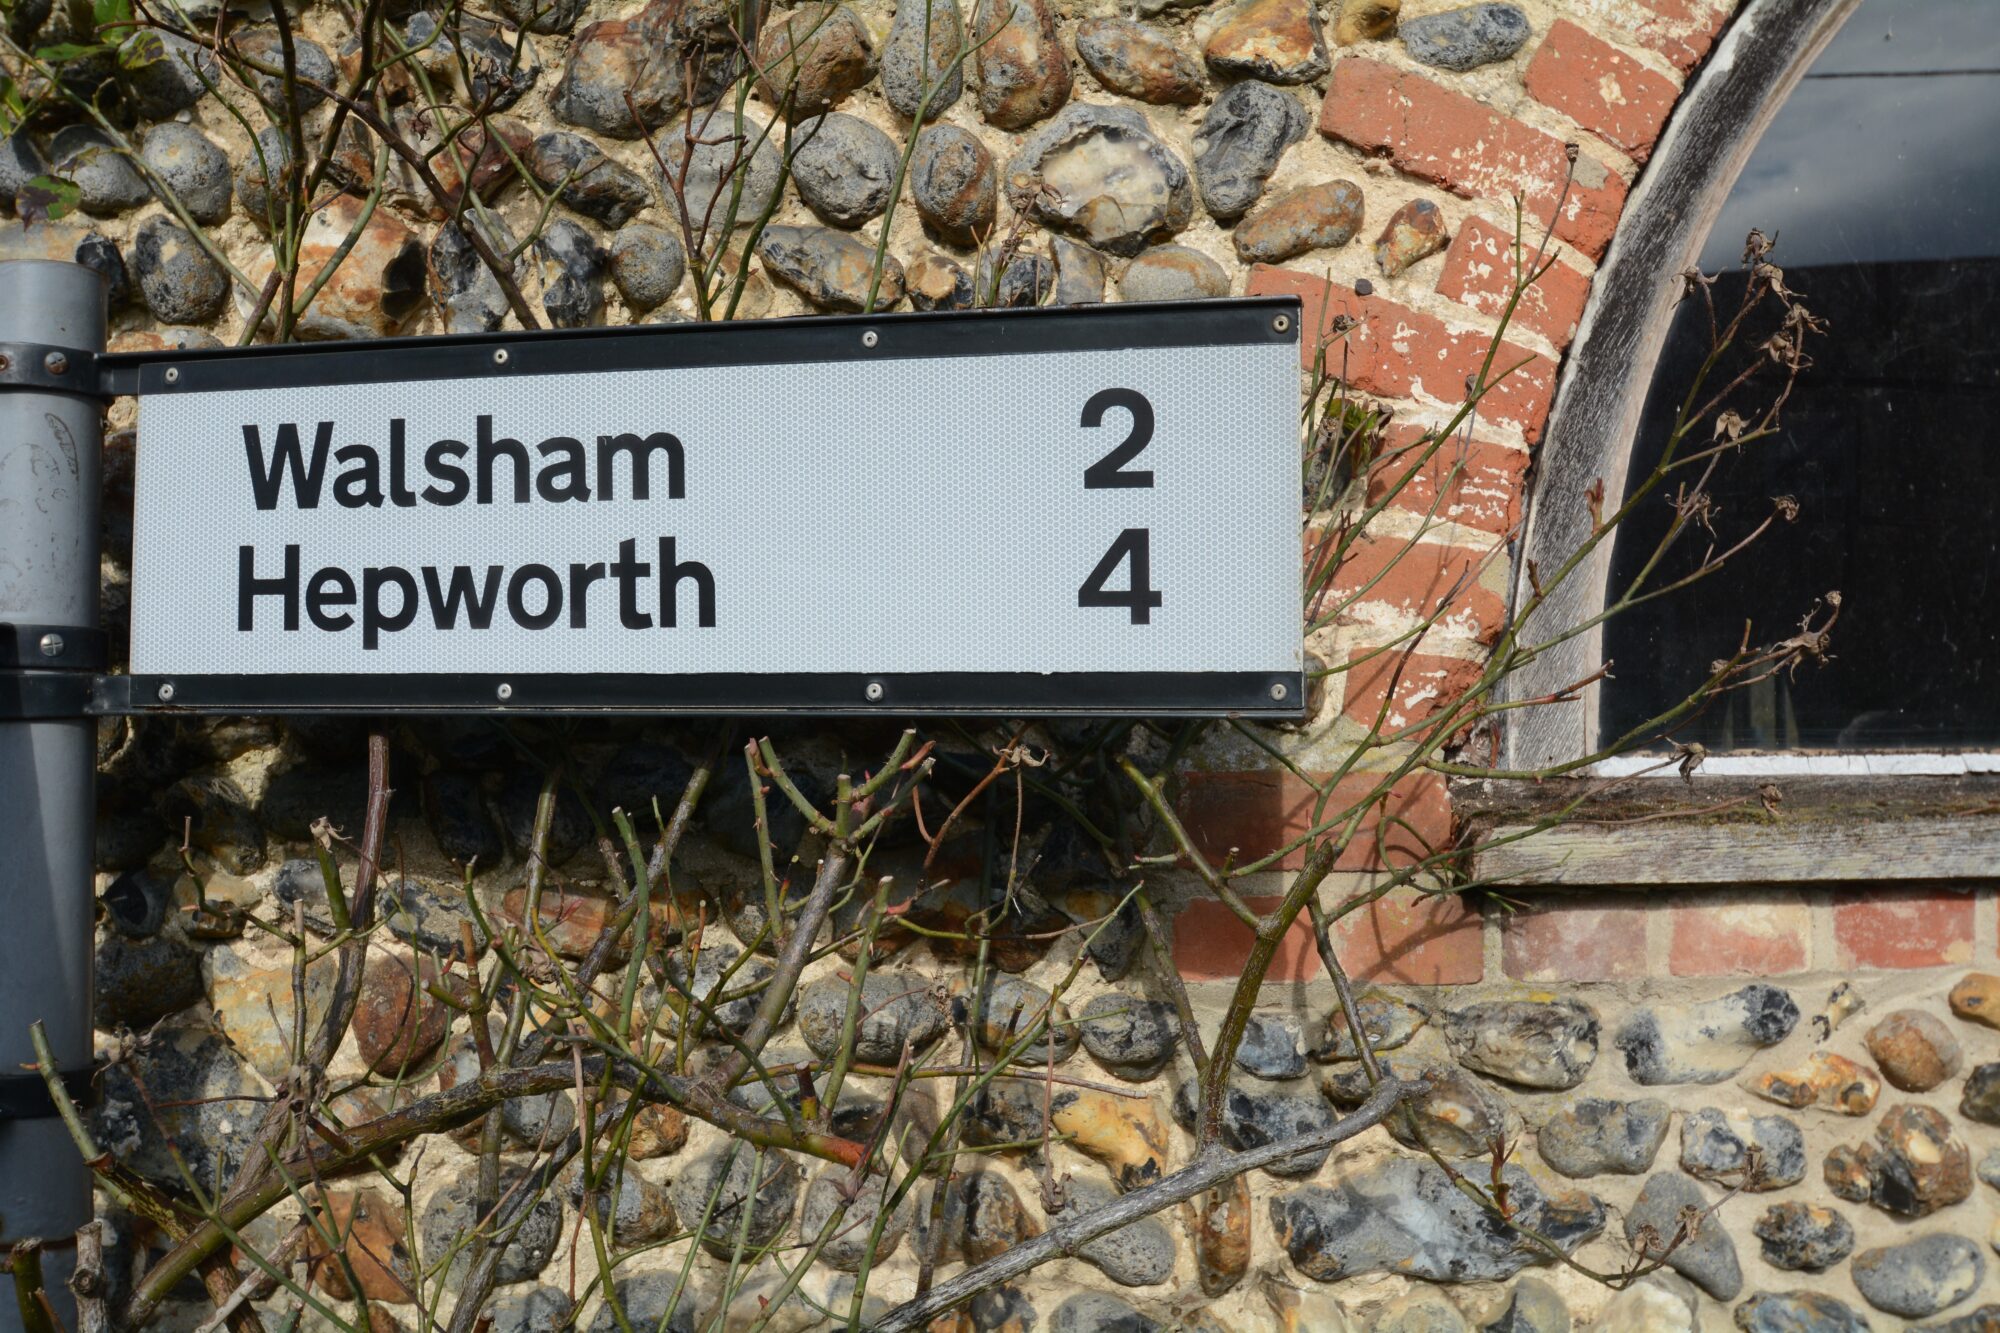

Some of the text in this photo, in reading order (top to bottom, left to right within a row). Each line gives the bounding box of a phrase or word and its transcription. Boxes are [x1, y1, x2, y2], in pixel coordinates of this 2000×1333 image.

[241, 387, 1155, 511] Walsham 2
[237, 528, 1162, 651] Hepworth 4
